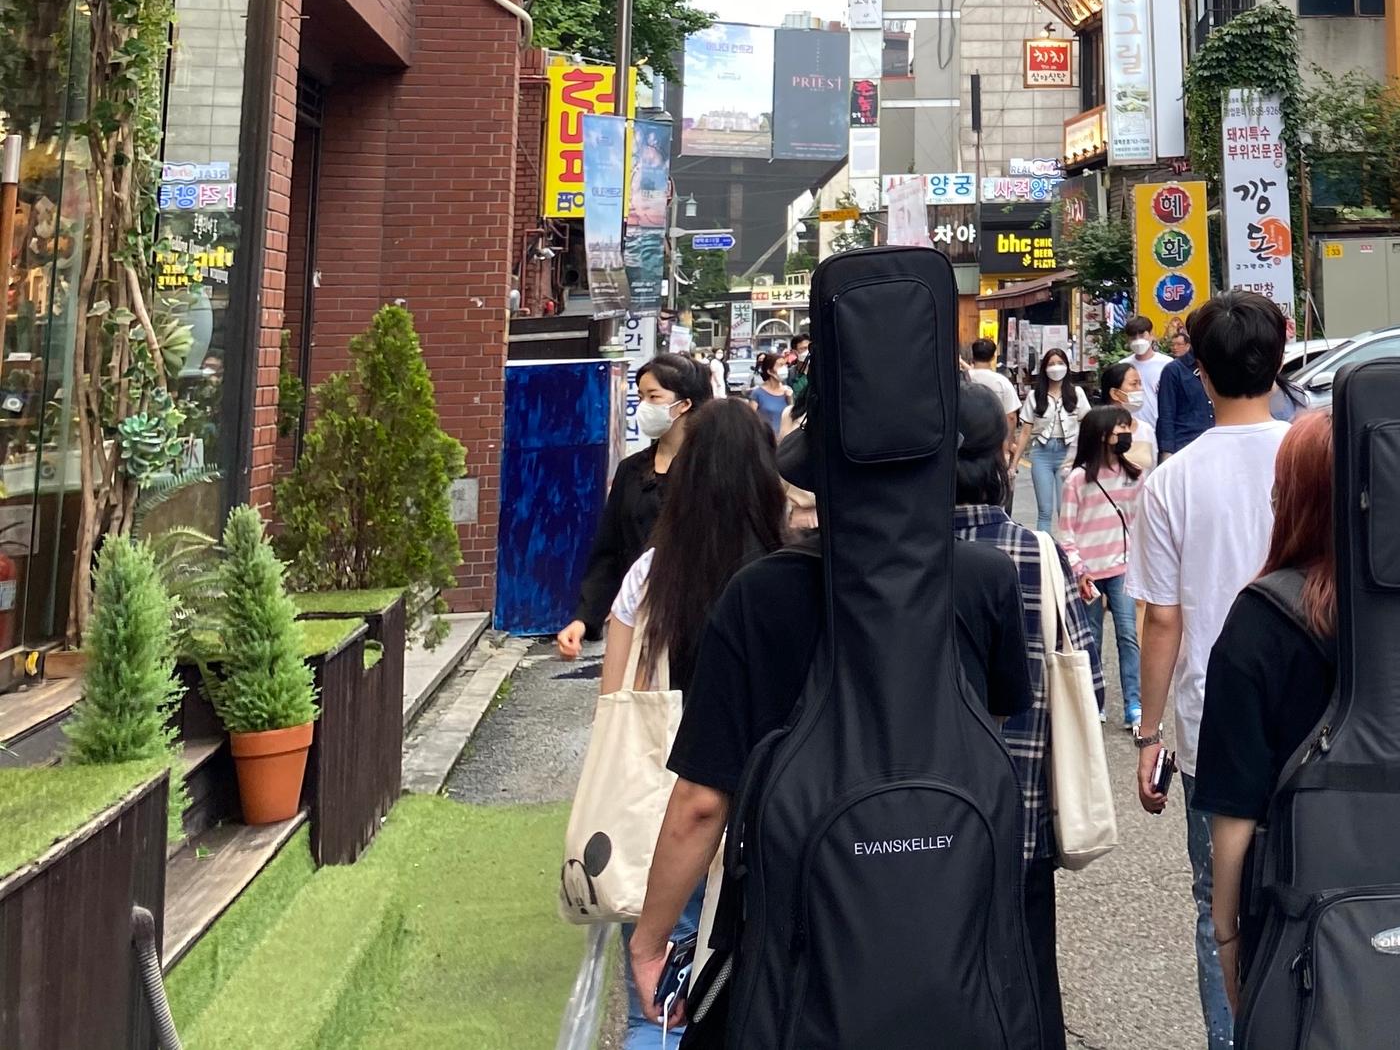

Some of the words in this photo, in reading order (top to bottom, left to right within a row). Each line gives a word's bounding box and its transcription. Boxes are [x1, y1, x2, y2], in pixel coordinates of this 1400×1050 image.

[1227, 142, 1284, 161] 부위전문점
[930, 174, 972, 196] 양궁
[997, 233, 1032, 253] bhc
[1033, 238, 1053, 248] CHIC
[771, 289, 811, 301] 낙산가
[1163, 284, 1186, 301] 5F
[854, 834, 954, 856] EVANSKELLEY
